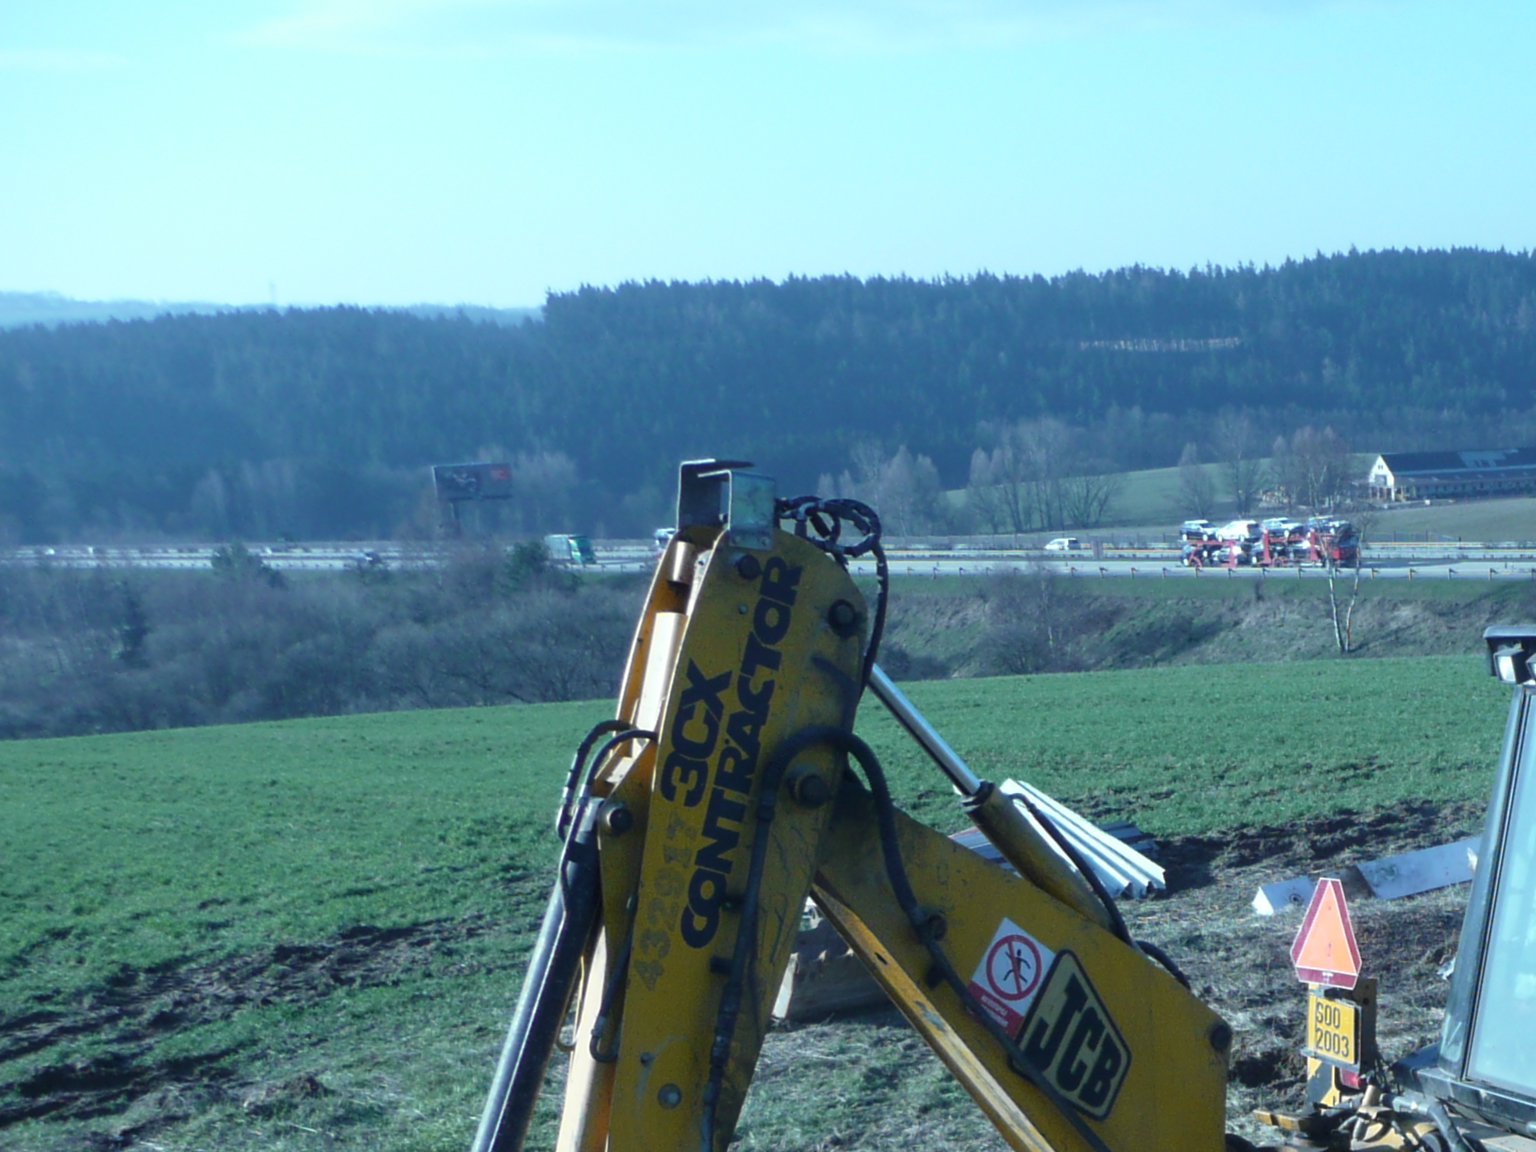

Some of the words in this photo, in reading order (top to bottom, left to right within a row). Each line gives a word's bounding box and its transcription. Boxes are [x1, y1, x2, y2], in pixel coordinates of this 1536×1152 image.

[661, 658, 732, 808] 3CX
[680, 556, 803, 949] CONTRACTOR
[1025, 972, 1122, 1108] JCB
[1315, 1027, 1350, 1058] 2003
